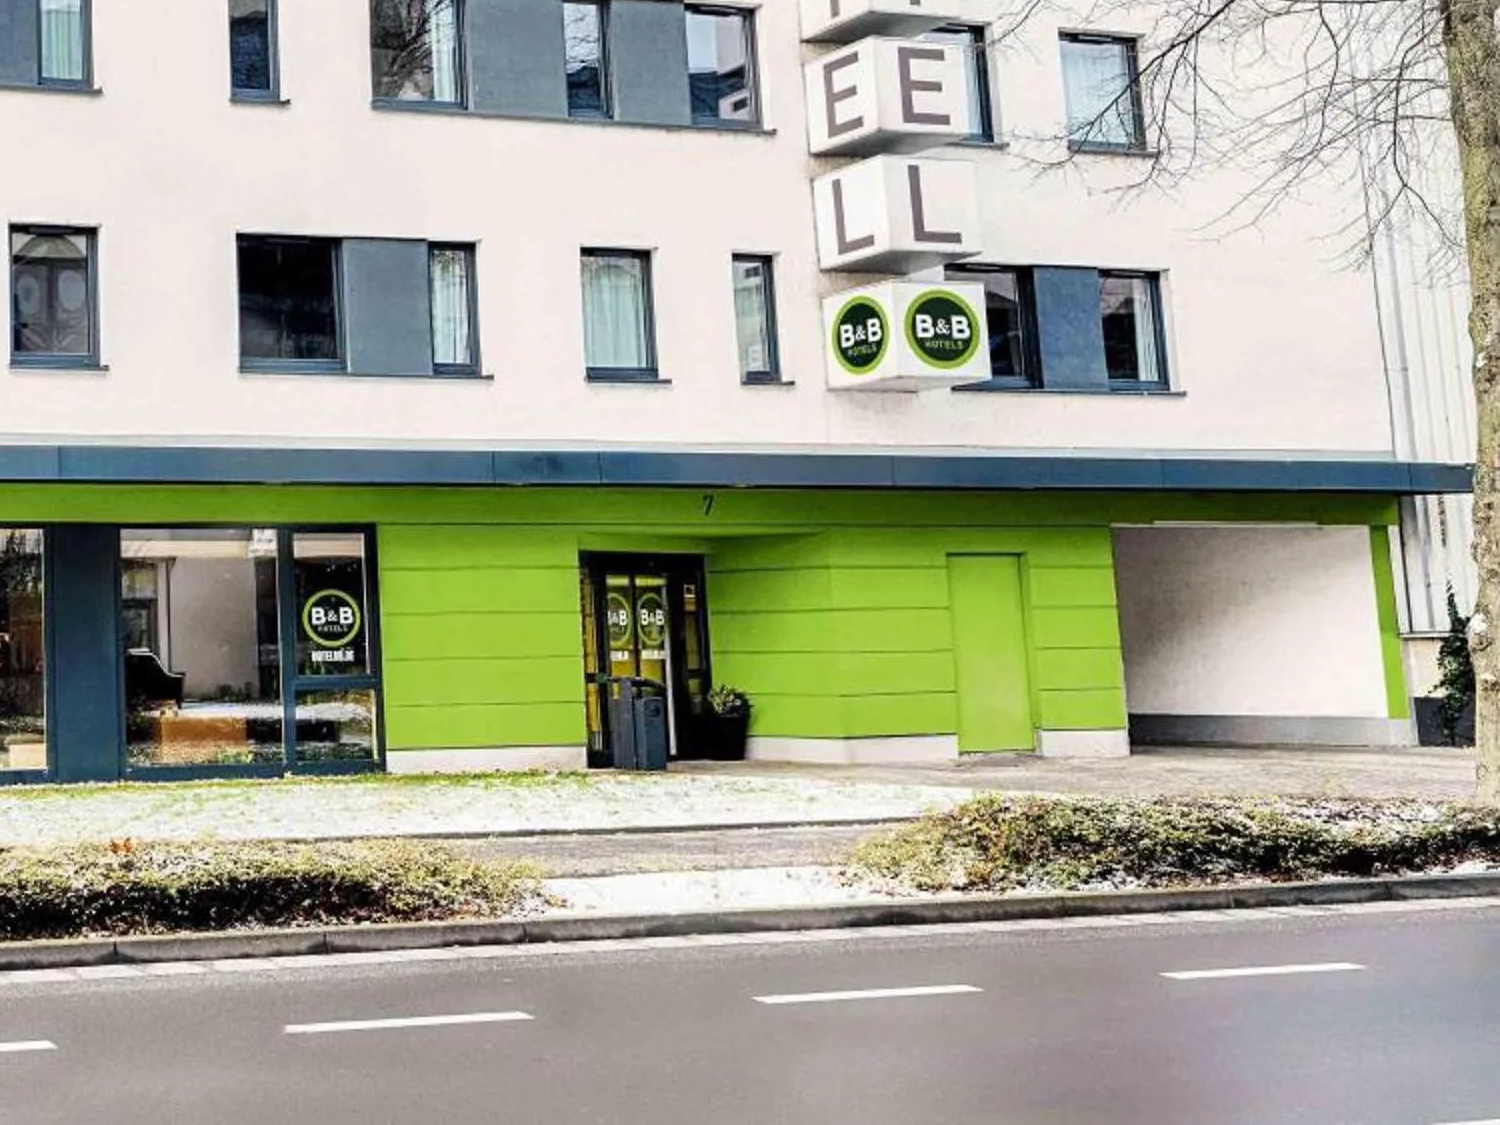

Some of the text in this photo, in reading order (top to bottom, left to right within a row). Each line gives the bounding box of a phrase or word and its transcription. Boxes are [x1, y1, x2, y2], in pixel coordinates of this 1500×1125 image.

[839, 317, 882, 348] B&B
[915, 314, 971, 339] B&B
[924, 339, 964, 350] HOTELS
[312, 607, 353, 624] B&B
